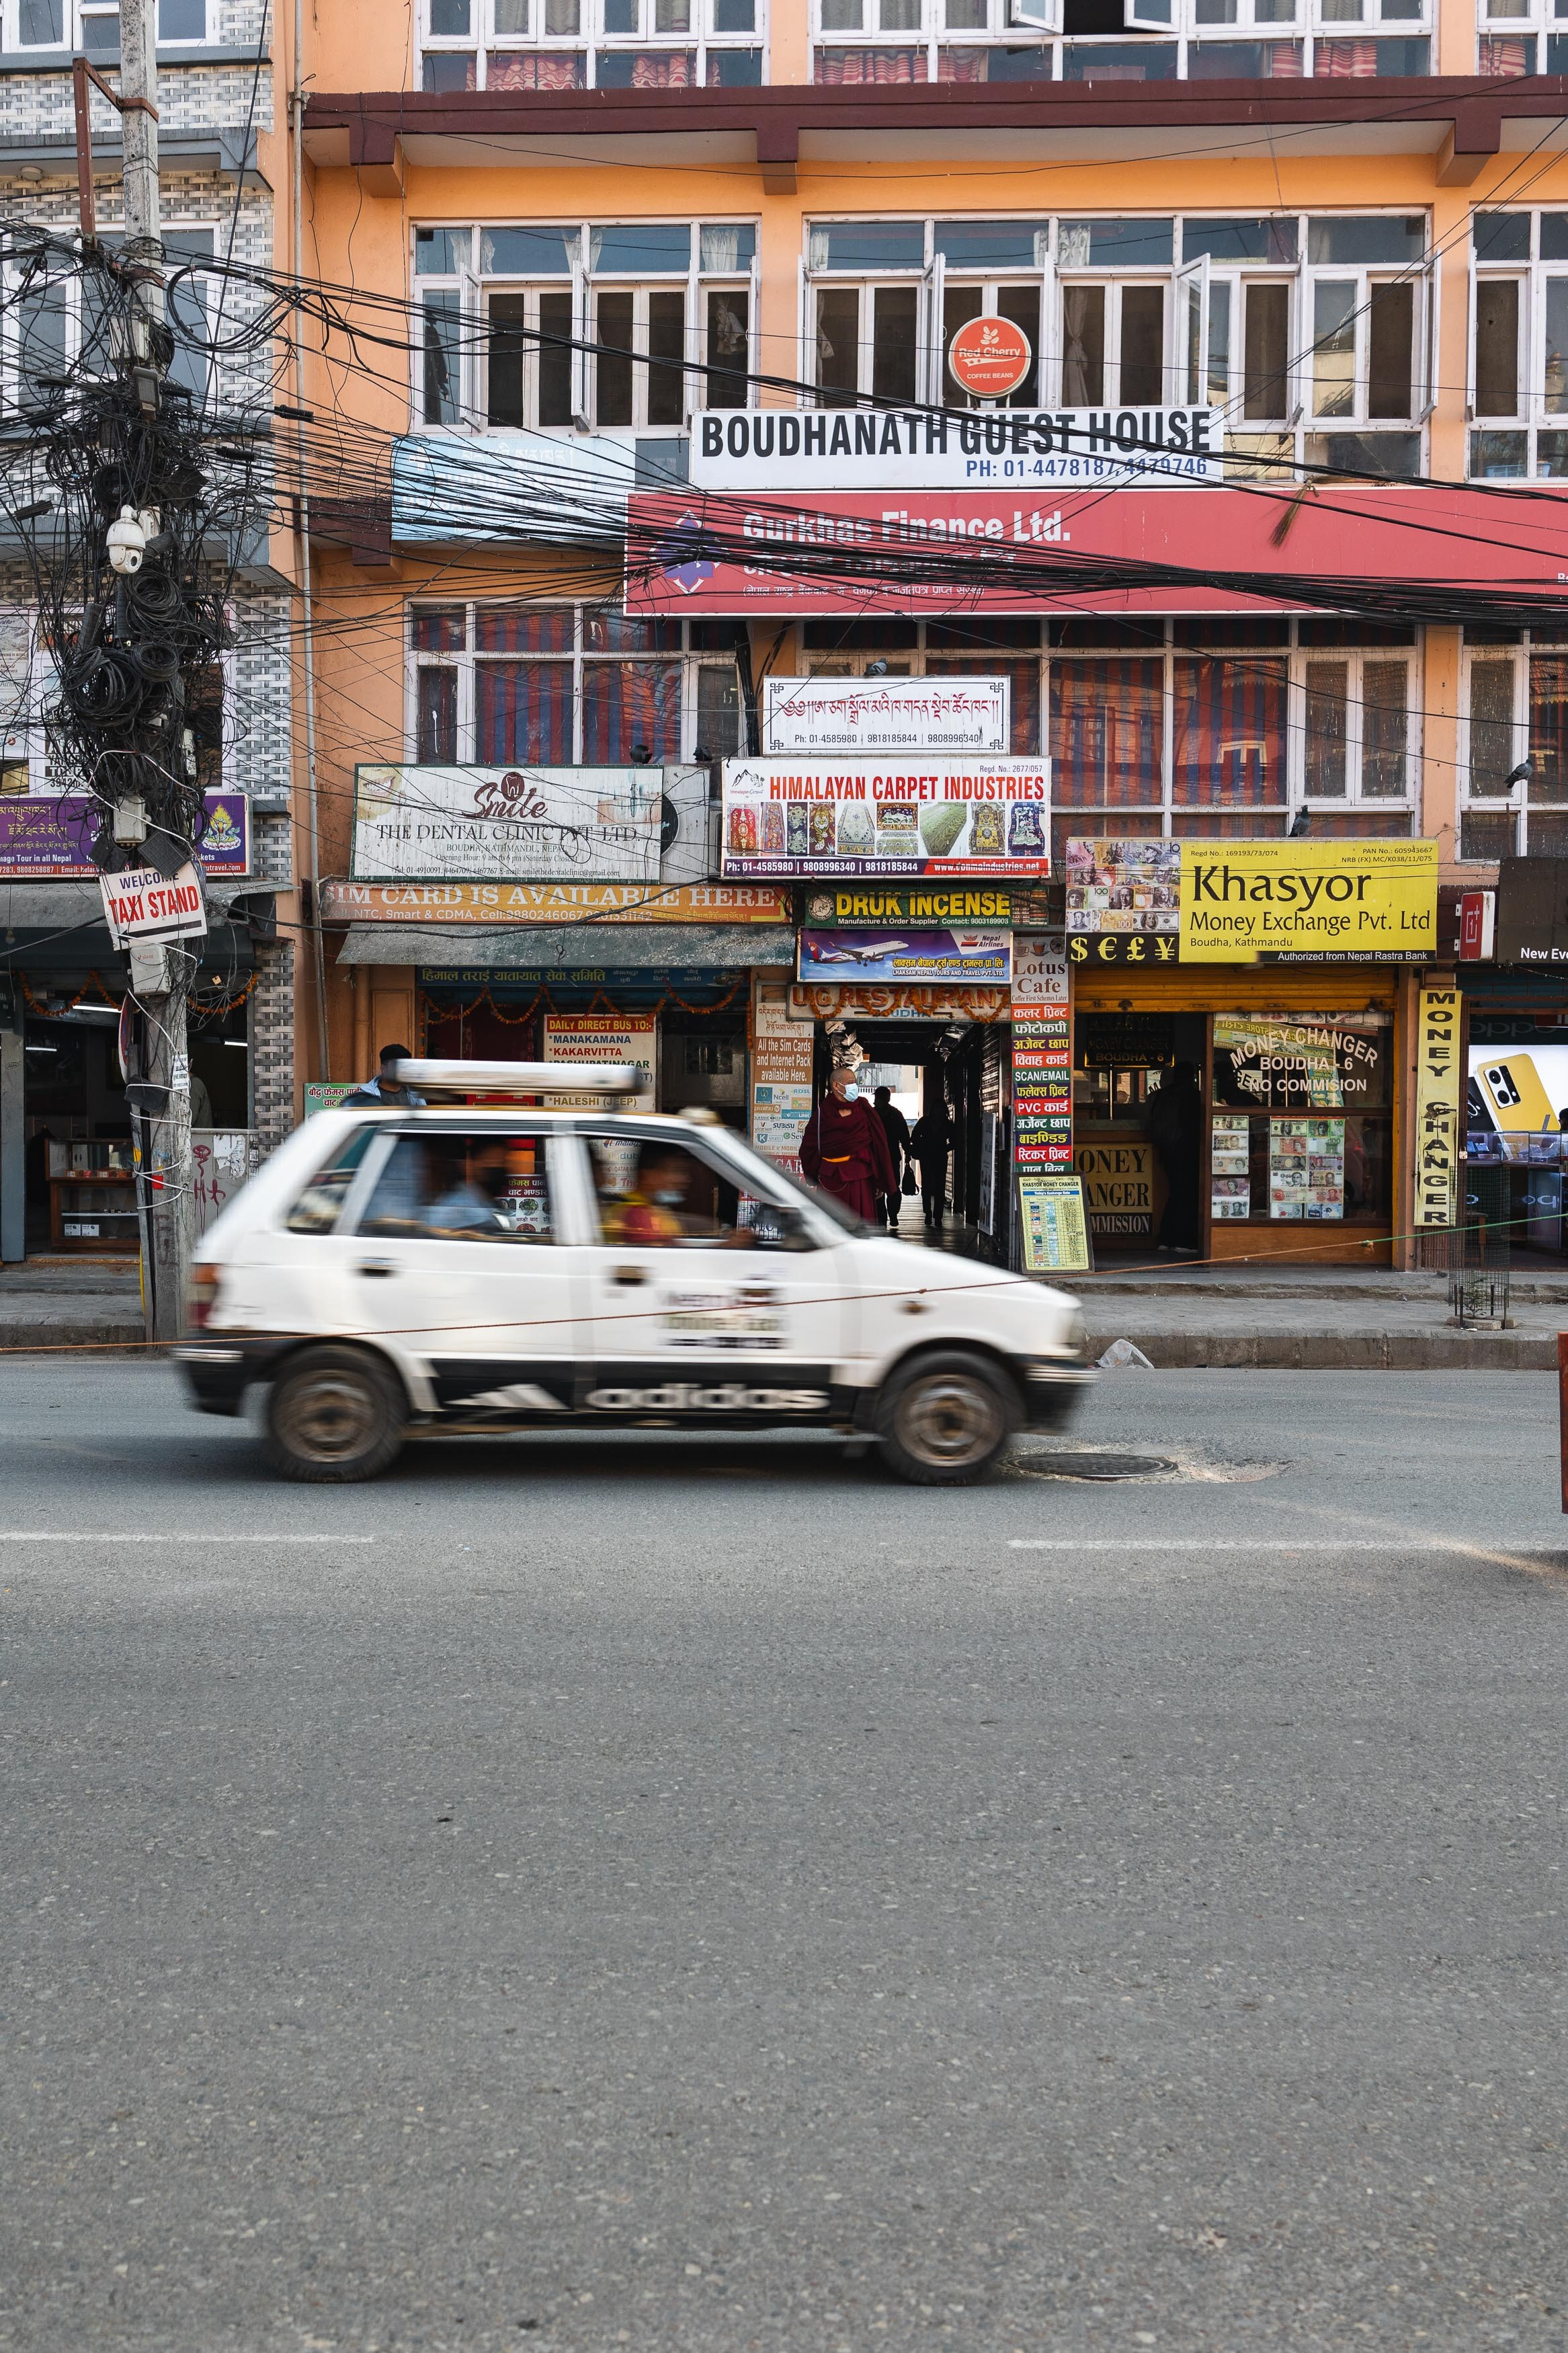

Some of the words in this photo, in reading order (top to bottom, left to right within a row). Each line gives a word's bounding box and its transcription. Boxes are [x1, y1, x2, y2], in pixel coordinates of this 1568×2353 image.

[958, 348, 981, 358] Red
[983, 347, 1021, 358] Cherry
[702, 415, 948, 458] BOUDHANATH
[960, 412, 1075, 455] GUEST
[1089, 411, 1210, 454] HOUSE
[966, 460, 997, 477] PH:
[743, 512, 872, 543] Gurkhas
[882, 511, 1004, 542] Finance
[1013, 510, 1071, 542] Ltd.
[794, 735, 807, 743] Ph:
[867, 734, 917, 743] 9818185844
[927, 733, 979, 743] 9808996340
[979, 765, 997, 774] Regd.
[770, 776, 866, 800] HIMALAYAN
[872, 776, 938, 800] CARPET
[944, 776, 1044, 800] INDUSTRIES
[468, 781, 548, 819] Smile
[376, 824, 411, 839] THE
[417, 825, 488, 840] DENTAL
[493, 826, 554, 841] CLINIC
[446, 844, 483, 853] BOUDHA,
[17, 854, 32, 863] Tour
[34, 854, 40, 863] in
[42, 854, 50, 863] all
[52, 854, 72, 863] Nepal
[437, 854, 462, 862] Opening
[727, 862, 740, 872] Ph:
[742, 862, 793, 872] 01-4585980
[802, 862, 856, 872] 9808996340
[865, 861, 918, 871] 9818185844
[1193, 865, 1372, 912] Khasyor
[381, 887, 463, 906] CARD
[470, 886, 499, 905] IS
[507, 886, 680, 907] AVAILABLE
[689, 887, 774, 907] HERE
[108, 895, 145, 925] TAXI
[148, 885, 200, 920] STAND
[836, 891, 902, 916] DRUK
[909, 891, 1011, 917] INCENSE
[355, 909, 382, 920] NTC,
[425, 910, 433, 919] &
[436, 910, 477, 921] CDMA,
[910, 918, 938, 926] Supplier
[1190, 912, 1255, 936] Money
[1263, 911, 1351, 936] Exchange
[1358, 911, 1392, 930] Pvt.
[1401, 910, 1430, 930] Ltd
[1070, 935, 1089, 962] $
[1098, 937, 1117, 961] €
[1126, 937, 1145, 961] £
[1155, 937, 1175, 961] ¥
[1190, 937, 1232, 948] Boudha,
[1235, 937, 1293, 947] Kathmandu
[1278, 952, 1324, 961] Authorized
[1325, 951, 1346, 961] from
[1348, 951, 1373, 963] Nepal
[1375, 951, 1403, 961] Rastra
[1405, 951, 1428, 961] Bank
[1520, 947, 1549, 960] New
[917, 957, 935, 968] नेपाल
[948, 959, 961, 968] एण्ड
[1013, 959, 1065, 975] Lotus
[422, 967, 458, 981] हिमाल
[462, 968, 490, 982] तराई
[494, 971, 541, 982] यातायात
[545, 968, 566, 982] सेवा
[571, 968, 606, 982] समिति
[1017, 978, 1061, 994] Cafe
[1014, 1008, 1041, 1019] कलर
[1044, 1004, 1067, 1019] प्रिन्ट
[549, 1020, 575, 1030] DAILY
[578, 1020, 611, 1030] DIRECT
[613, 1020, 632, 1030] BUS
[1015, 1021, 1067, 1034] फोटोकपी
[1425, 992, 1456, 1077] MONEY
[757, 1039, 767, 1051] All
[768, 1039, 778, 1051] the
[780, 1039, 792, 1051] Sim
[793, 1039, 811, 1052] Cards
[1048, 1039, 1069, 1049] छाप
[1229, 1028, 1290, 1069] MONEY
[1295, 1027, 1378, 1068] CHANGER
[757, 1054, 768, 1066] and
[770, 1054, 794, 1066] Internet
[796, 1055, 811, 1067] Pack
[1015, 1053, 1043, 1066] विवाह
[1046, 1052, 1069, 1065] कार्ड
[1096, 1053, 1147, 1062] BOUDHA
[1260, 1057, 1330, 1070] BOUDHA
[1344, 1057, 1353, 1070] 6
[761, 1068, 789, 1082] available
[790, 1070, 807, 1082] Here.
[1015, 1070, 1070, 1082] SCAN/EMAIL
[323, 1086, 345, 1096] फेमस
[1049, 1083, 1068, 1098] प्रिन्ट
[1249, 1078, 1272, 1092] NO
[1277, 1078, 1367, 1092] COMMISION
[603, 1096, 637, 1107] (JEEP)
[1018, 1103, 1041, 1113] PVC
[1044, 1100, 1069, 1113] कार्ड
[1050, 1118, 1071, 1129] छाप
[1018, 1147, 1046, 1160] स्टिकर
[1048, 1146, 1069, 1161] प्रिन्ट
[1423, 1101, 1450, 1224] CHANGER
[586, 1382, 832, 1410] adidas
